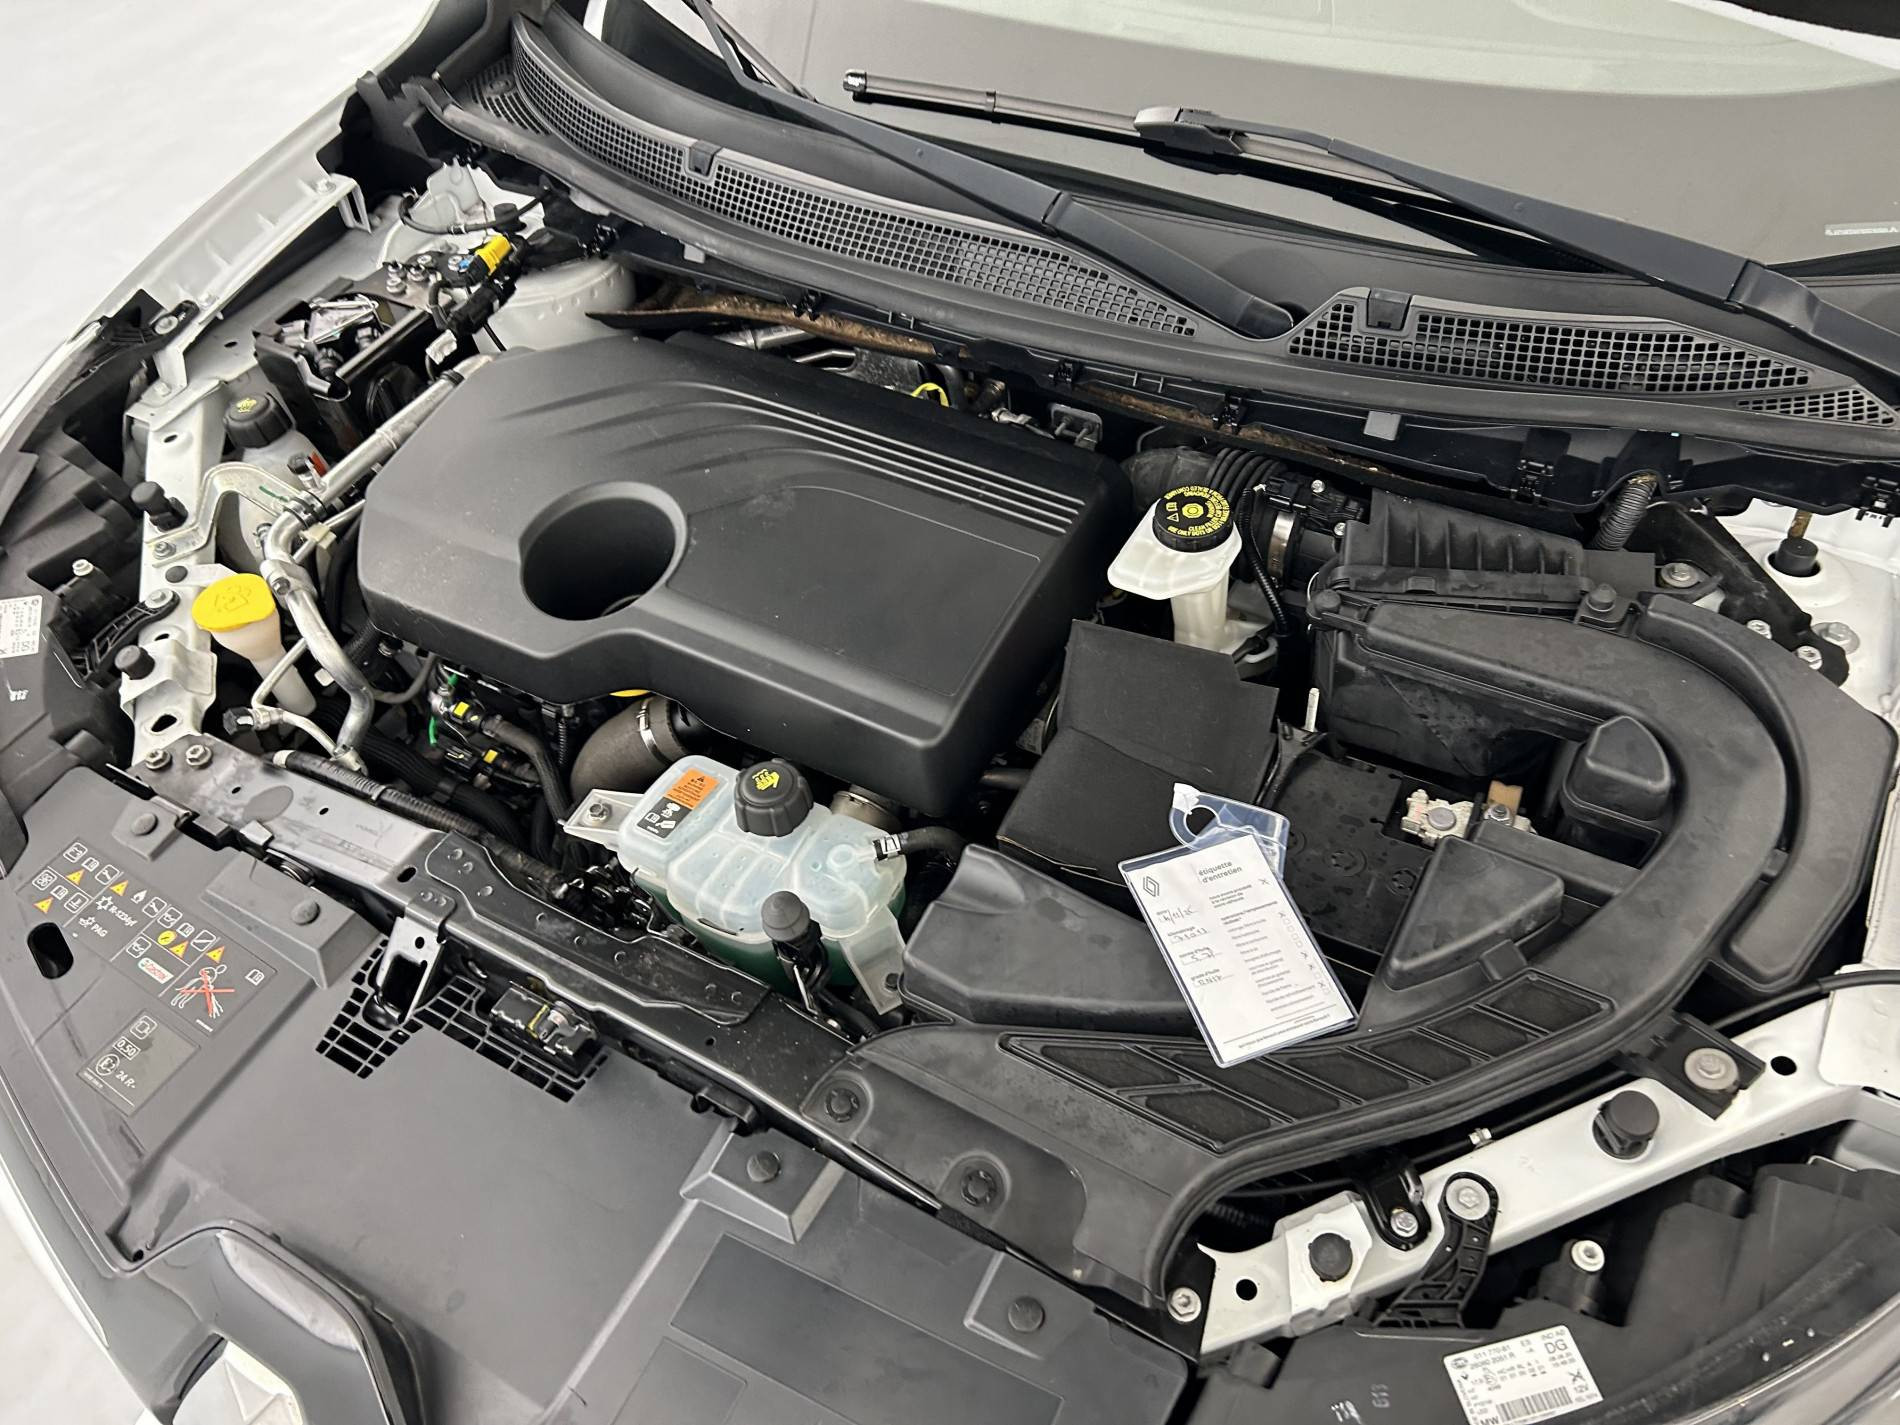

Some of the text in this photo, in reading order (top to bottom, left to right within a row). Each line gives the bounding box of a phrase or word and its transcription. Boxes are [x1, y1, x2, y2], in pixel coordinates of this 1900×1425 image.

[1164, 486, 1190, 500] CONTAINER
[1198, 861, 1233, 877] étiquette
[1202, 866, 1243, 884] d'entretien
[90, 923, 109, 938] PAG
[116, 1039, 137, 1057] 0,50
[1543, 1338, 1568, 1355] DG
